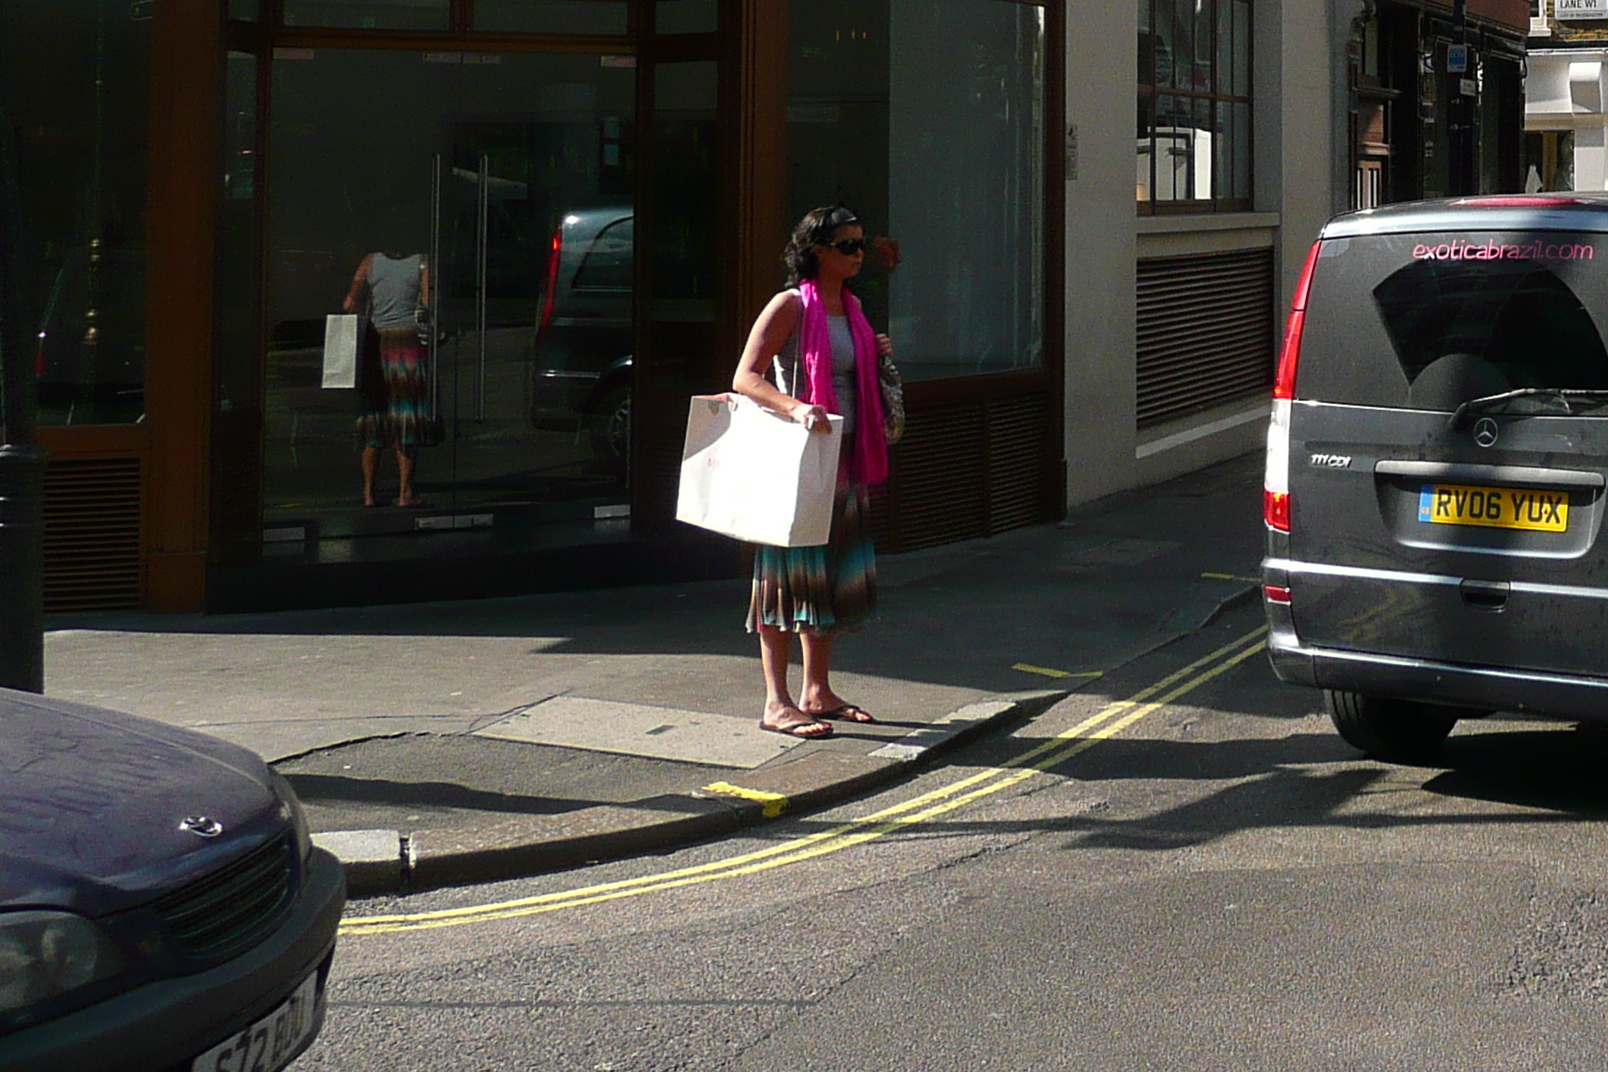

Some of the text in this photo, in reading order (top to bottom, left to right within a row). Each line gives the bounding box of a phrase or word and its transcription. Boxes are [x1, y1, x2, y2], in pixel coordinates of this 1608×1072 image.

[1560, 0, 1597, 9] LANE W1
[1412, 239, 1594, 260] exoticabrazil.com
[1436, 489, 1563, 524] RV06 YUX
